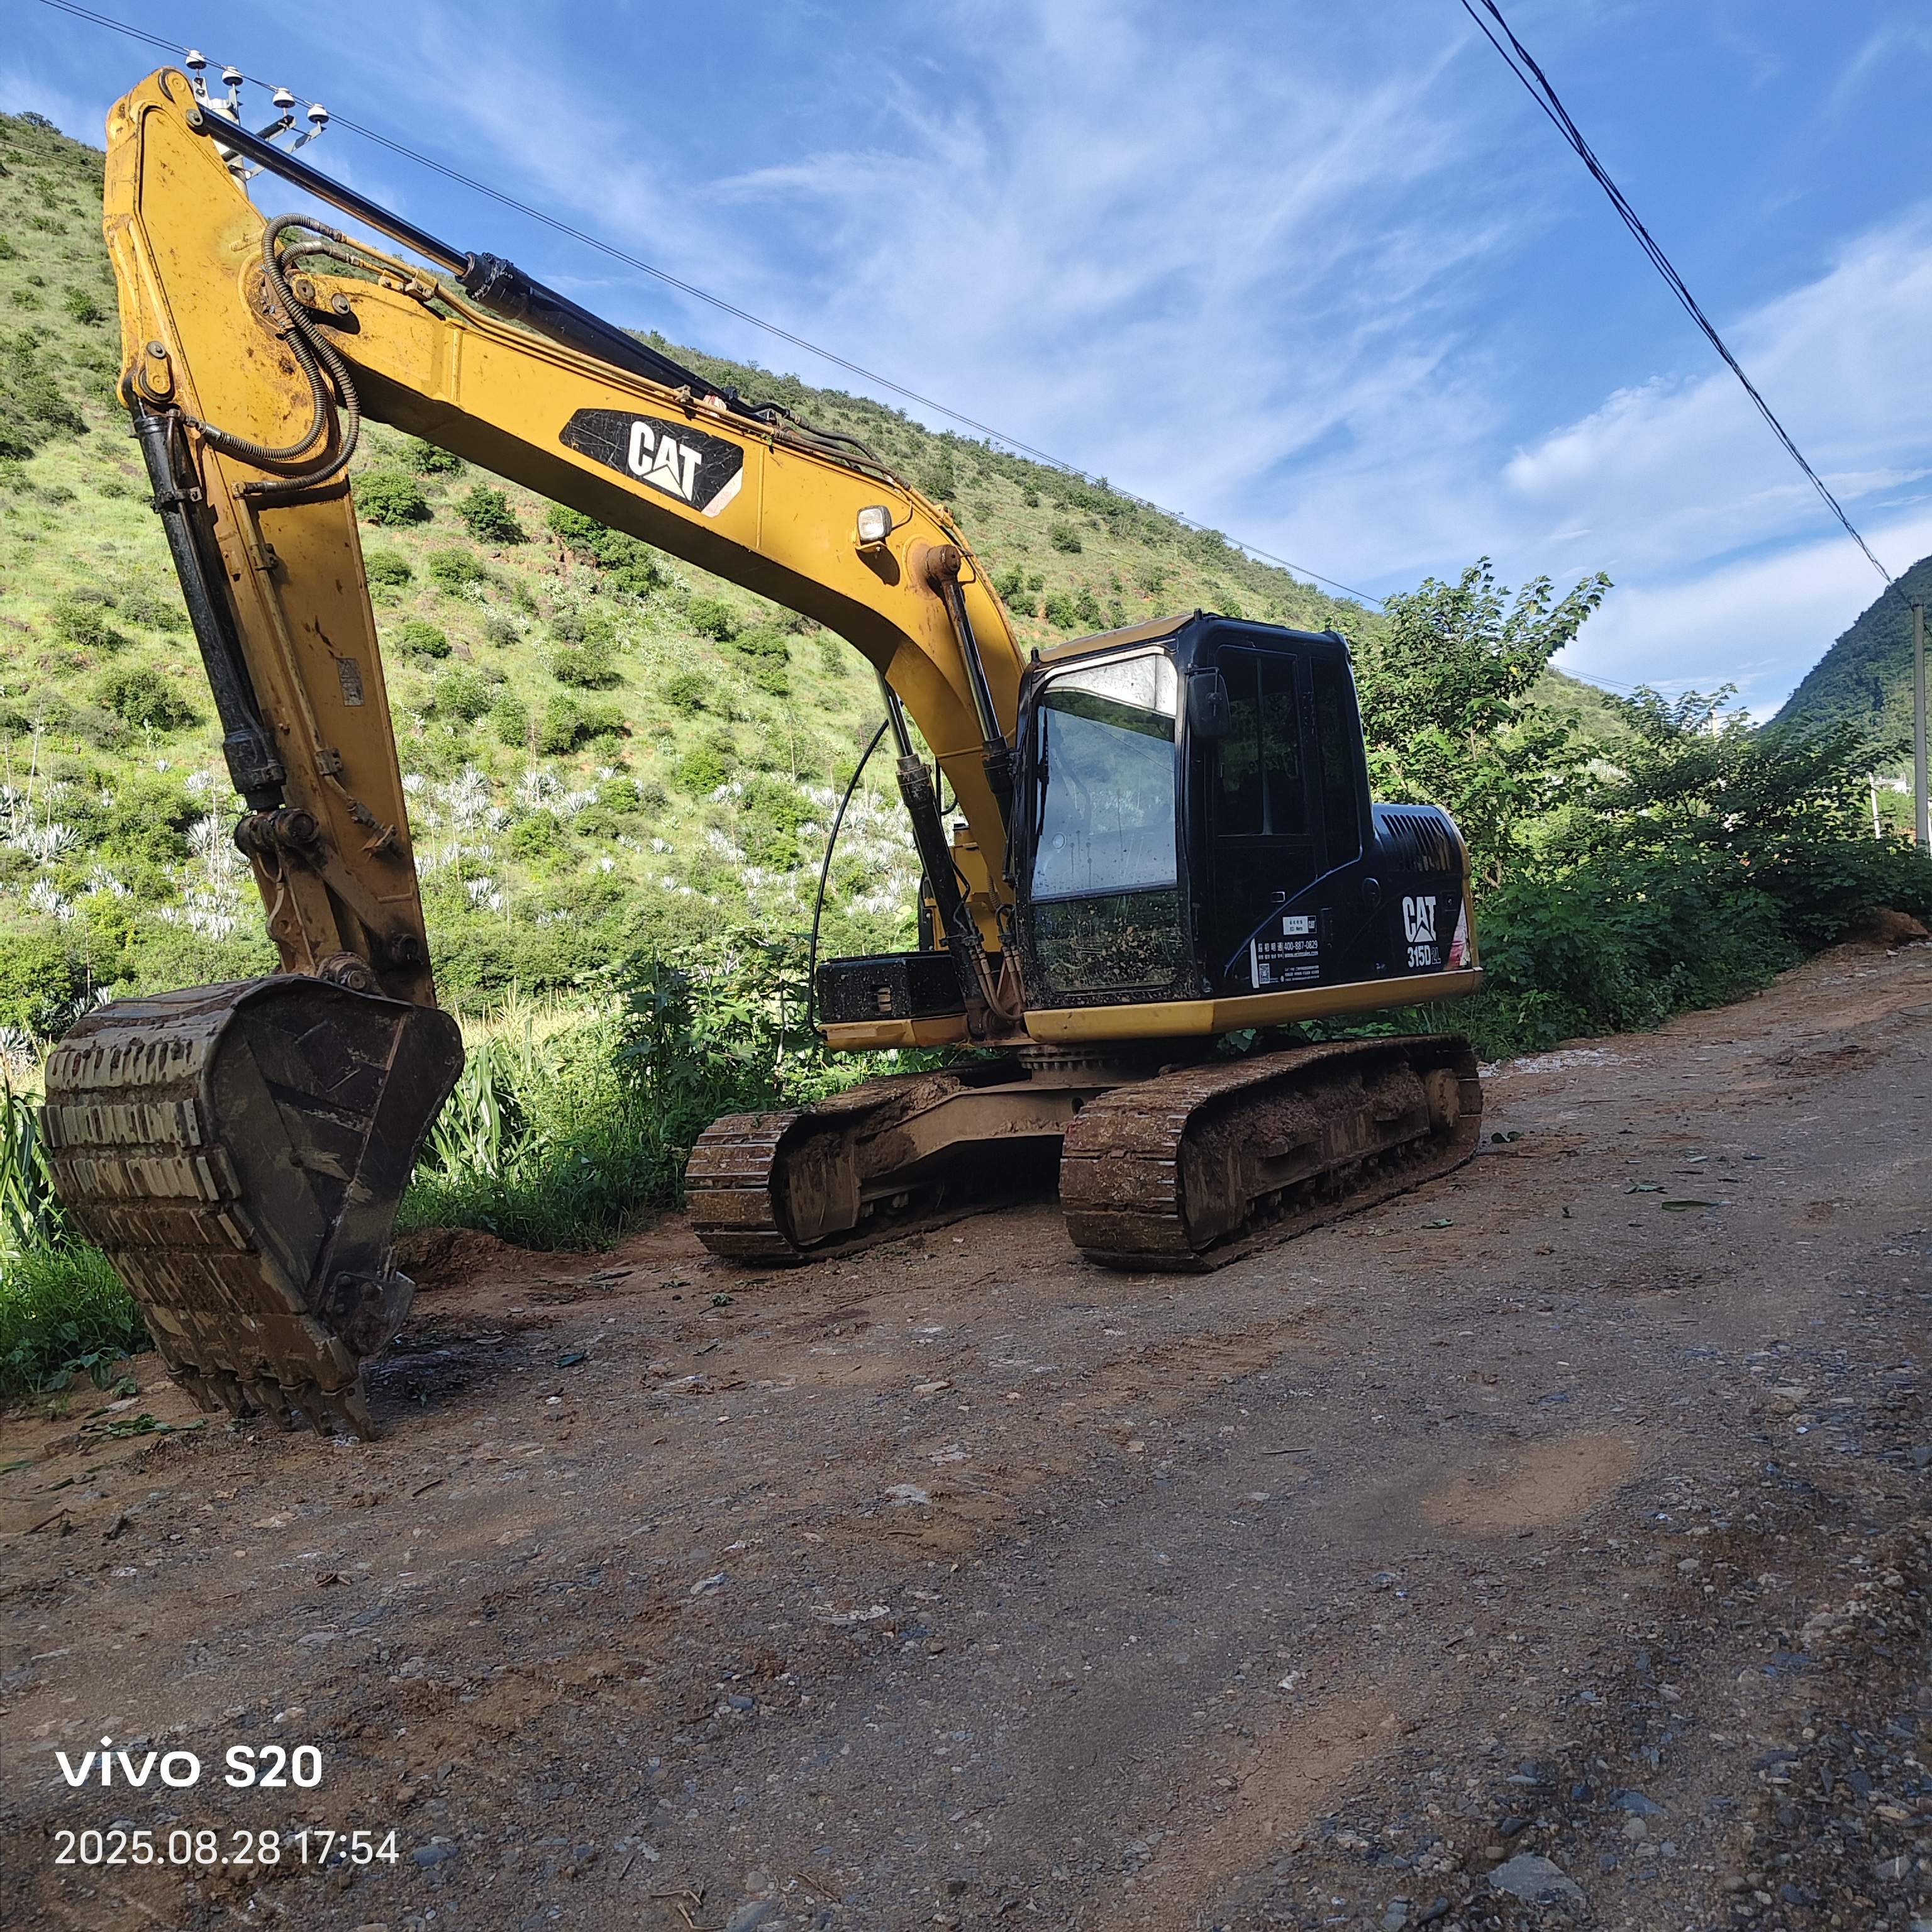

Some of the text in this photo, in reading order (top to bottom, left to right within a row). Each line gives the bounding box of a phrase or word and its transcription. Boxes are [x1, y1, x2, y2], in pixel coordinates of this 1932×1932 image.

[628, 421, 702, 501] CAT
[1402, 896, 1436, 943] CAT
[1284, 940, 1318, 951] 400-887-0829
